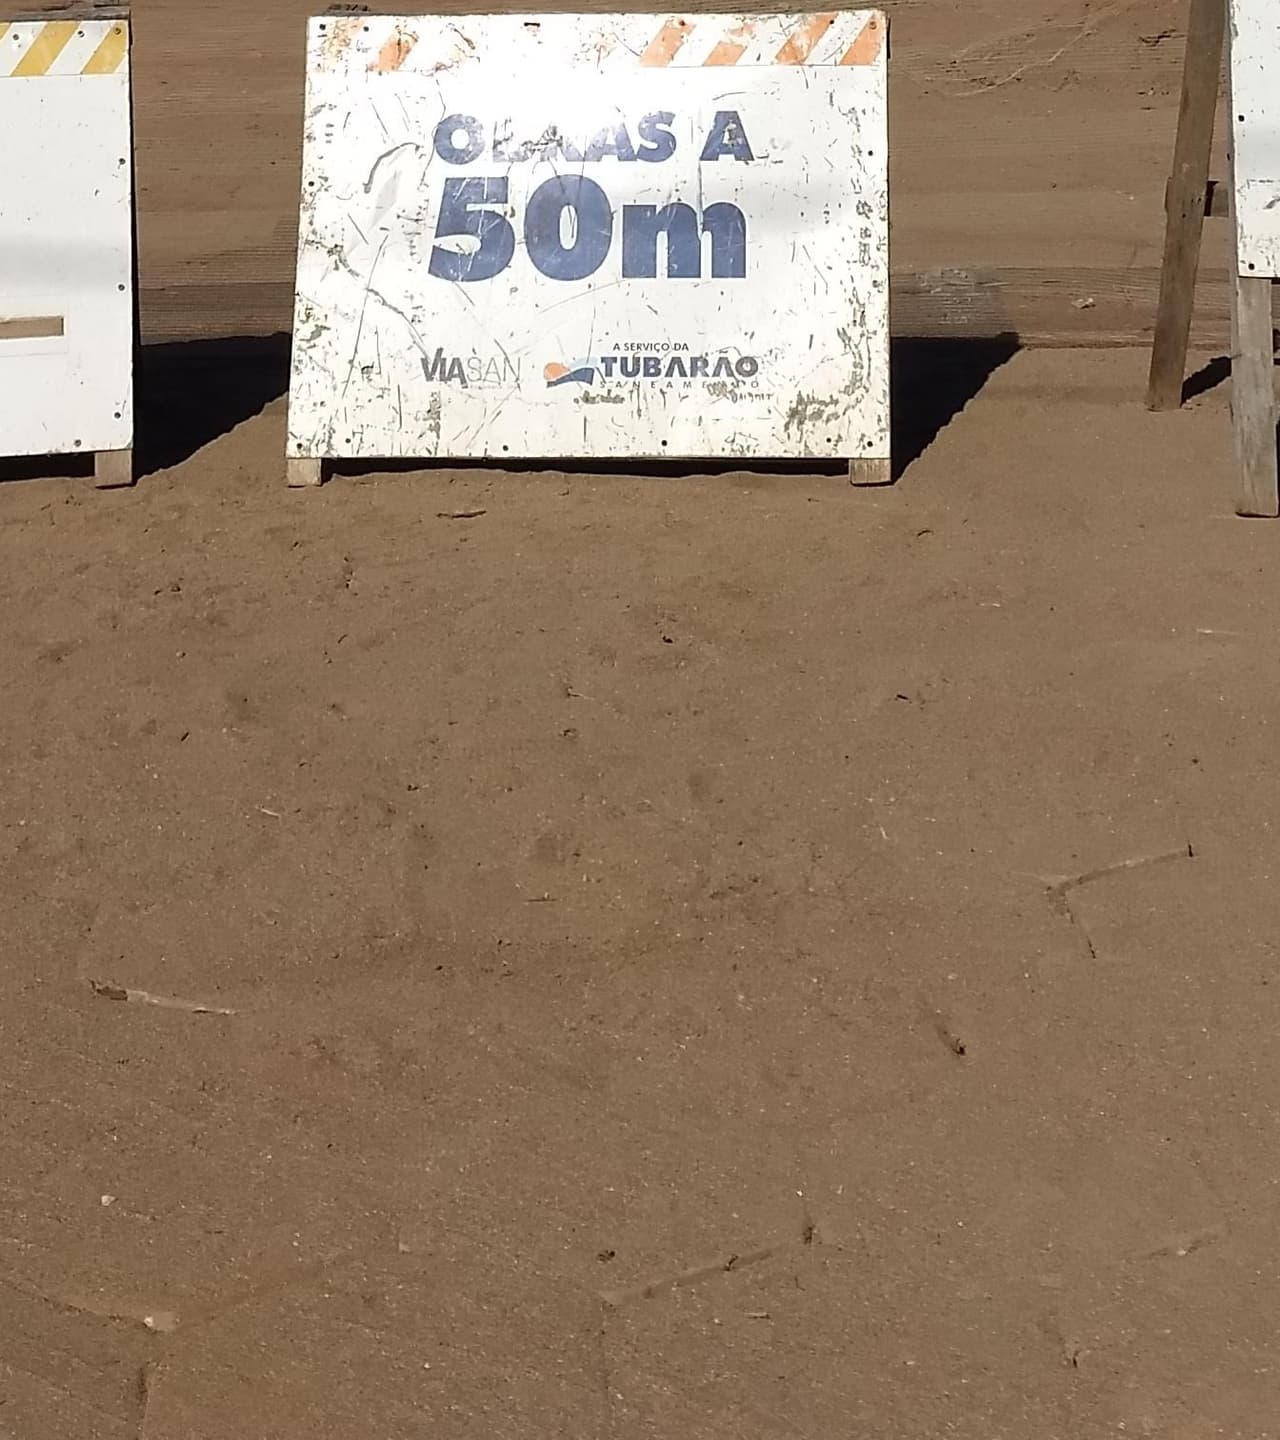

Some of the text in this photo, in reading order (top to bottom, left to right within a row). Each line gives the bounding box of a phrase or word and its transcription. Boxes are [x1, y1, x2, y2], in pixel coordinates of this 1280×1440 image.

[699, 111, 755, 161] A
[428, 174, 747, 282] 50m
[600, 349, 759, 378] TUBARÃO
[613, 342, 690, 355] A SERVIÇO DA
[420, 347, 521, 389] VIASAN
[598, 378, 761, 390] SANEAMEO
